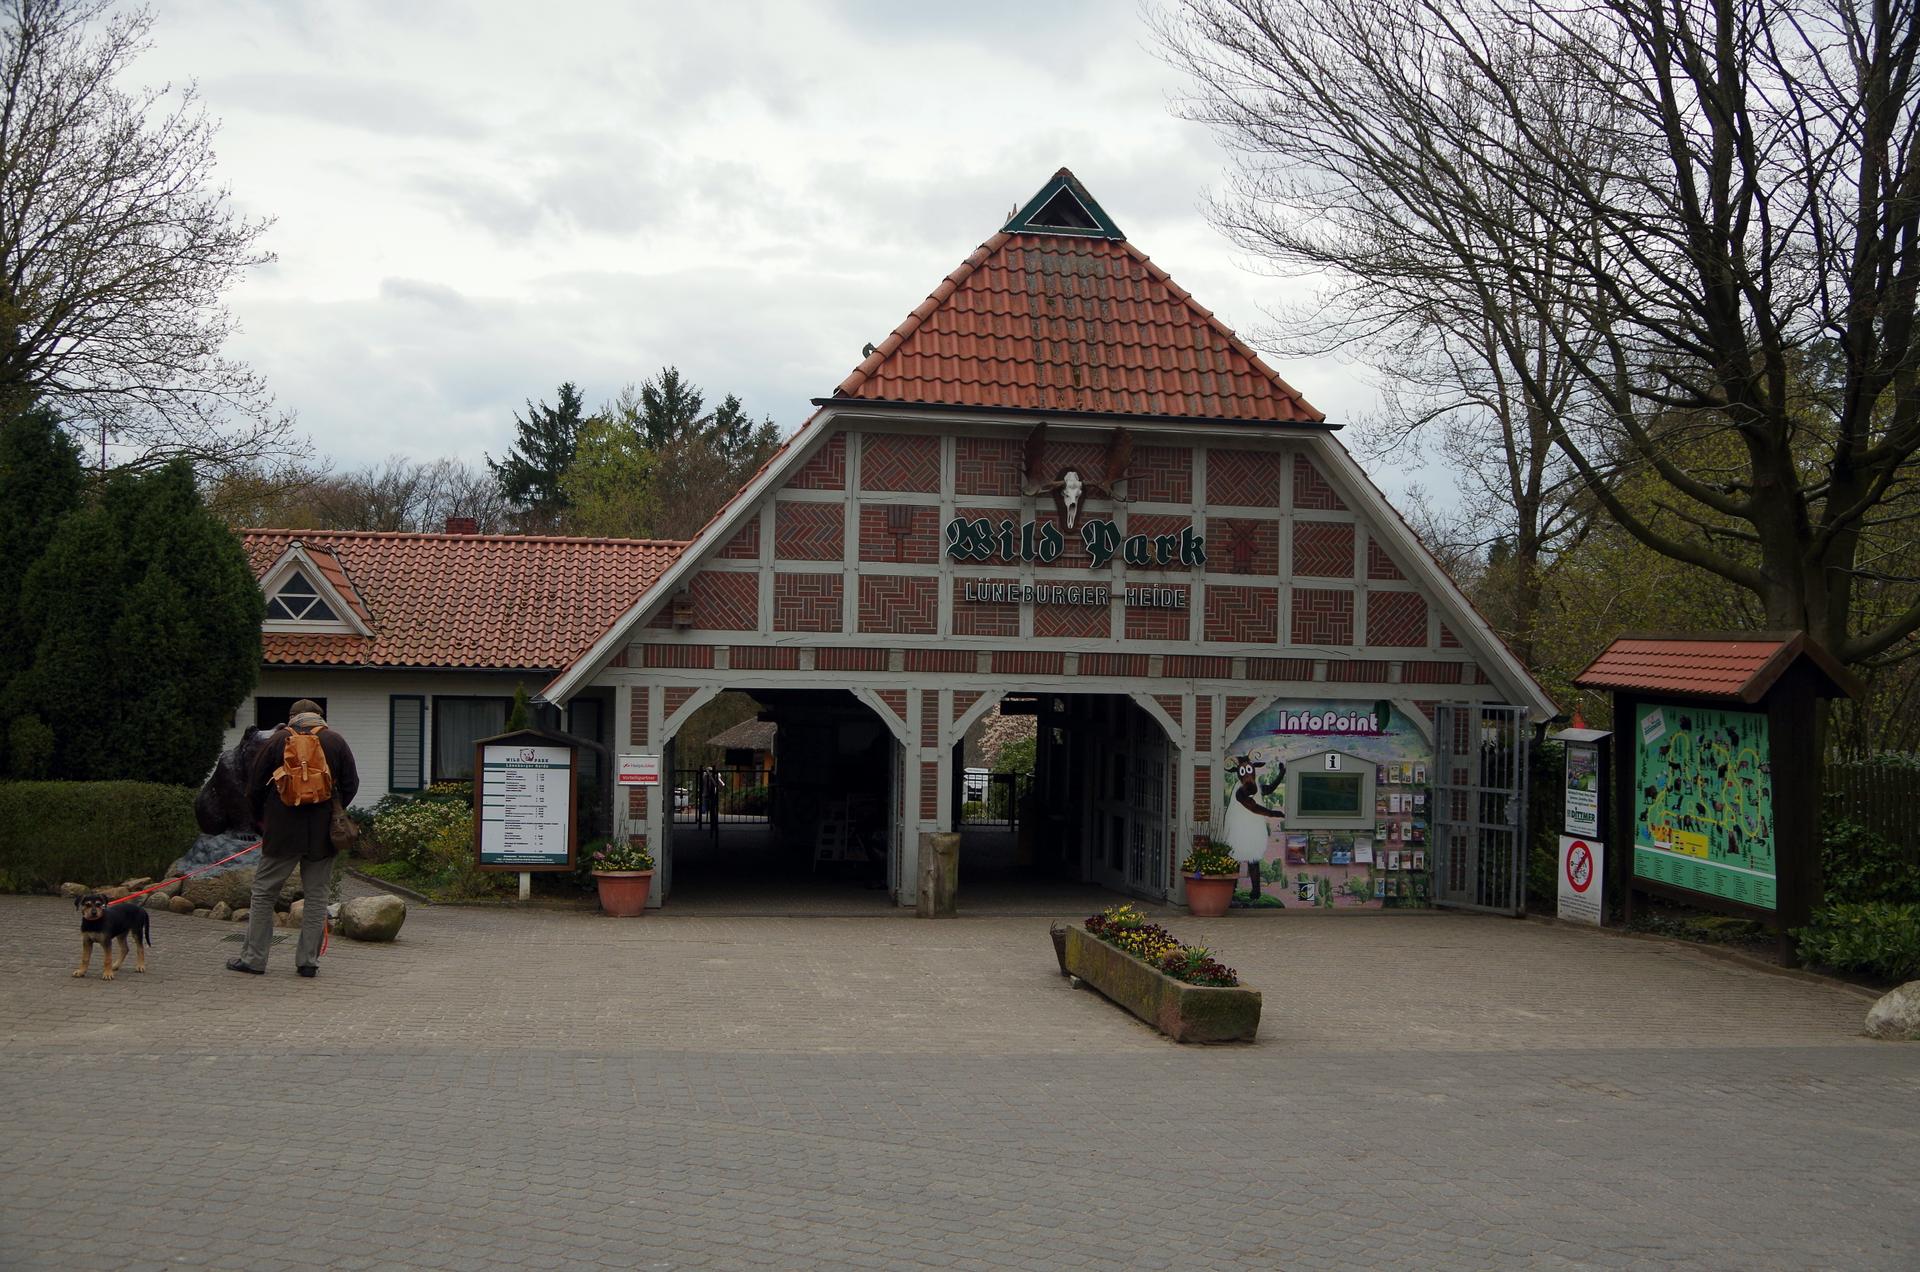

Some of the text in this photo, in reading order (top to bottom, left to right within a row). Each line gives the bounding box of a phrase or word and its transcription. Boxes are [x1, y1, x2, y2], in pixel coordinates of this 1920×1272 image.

[945, 517, 1208, 568] Wild Park
[965, 577, 1186, 608] LÜNEBURGER HEIDE
[1279, 711, 1378, 731] InfoPoint
